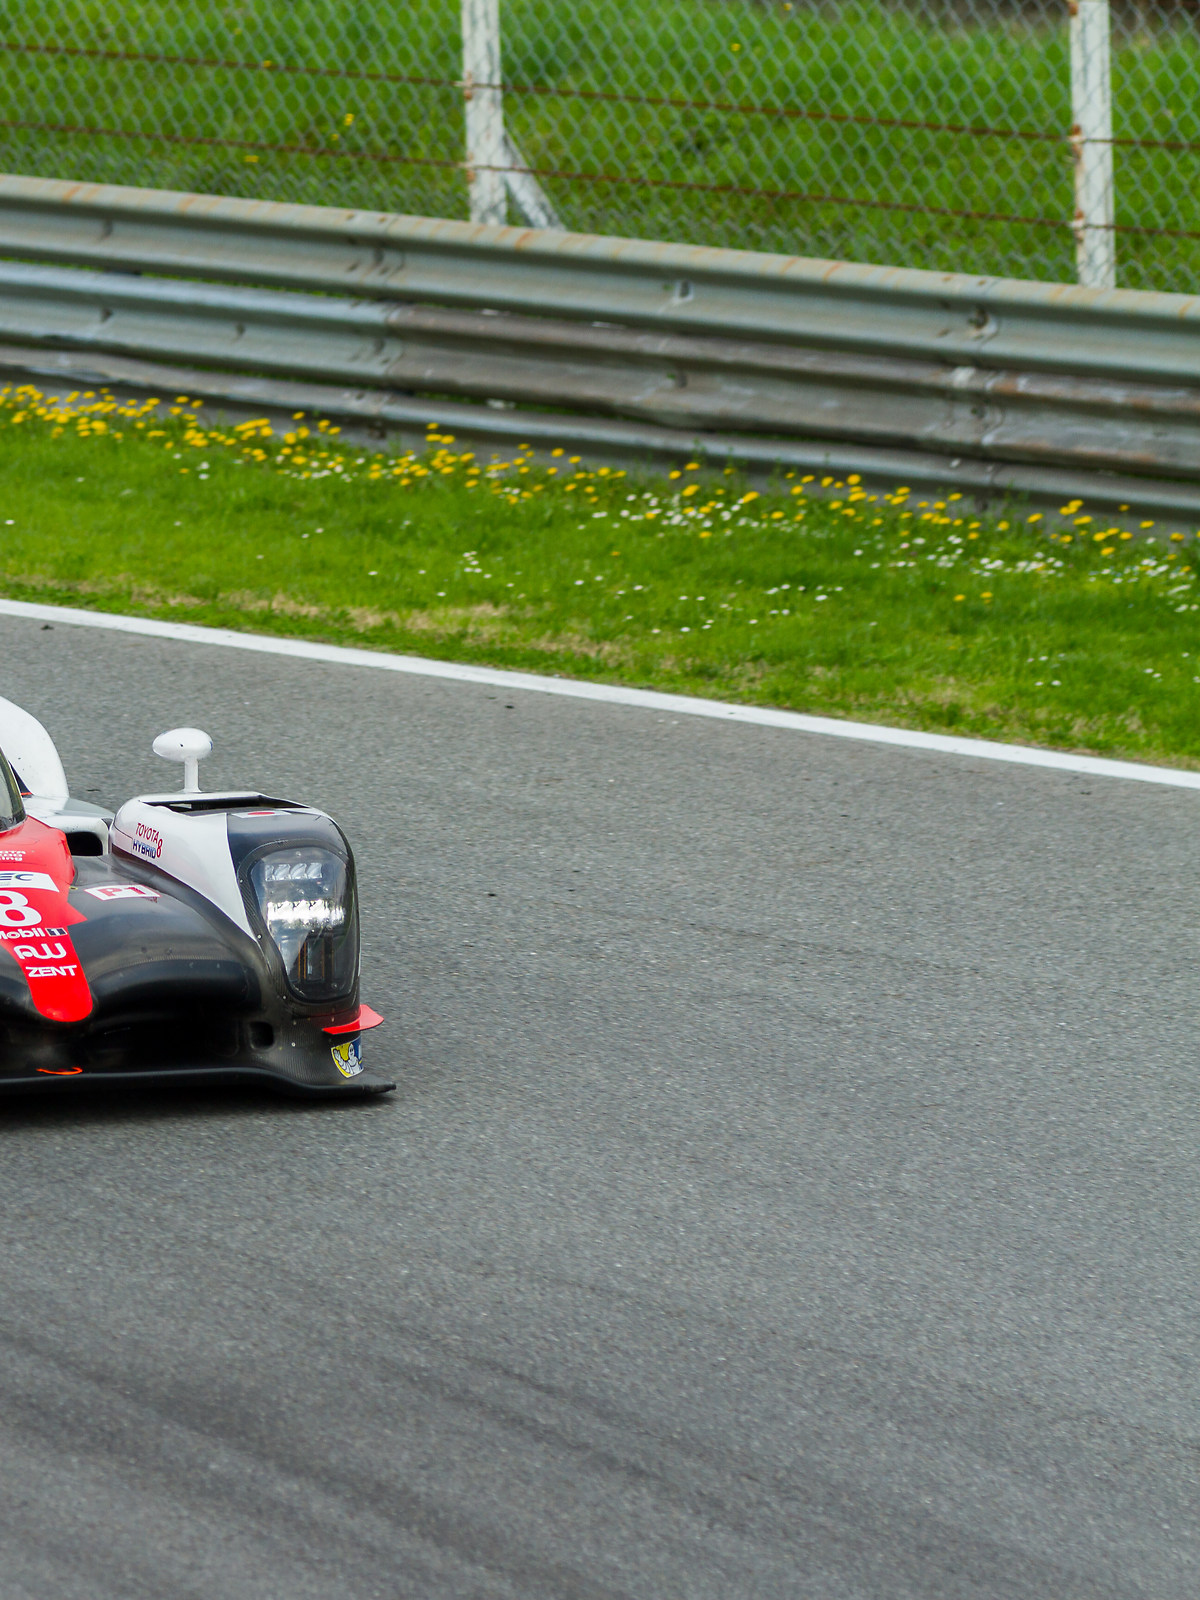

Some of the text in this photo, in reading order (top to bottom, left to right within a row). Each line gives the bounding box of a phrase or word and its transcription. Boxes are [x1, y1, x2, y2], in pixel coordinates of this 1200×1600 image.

[136, 822, 160, 845] TOYOTA
[132, 839, 157, 860] HYBRID
[156, 838, 163, 858] 8
[97, 886, 147, 897] P1
[25, 964, 78, 978] ZENT
